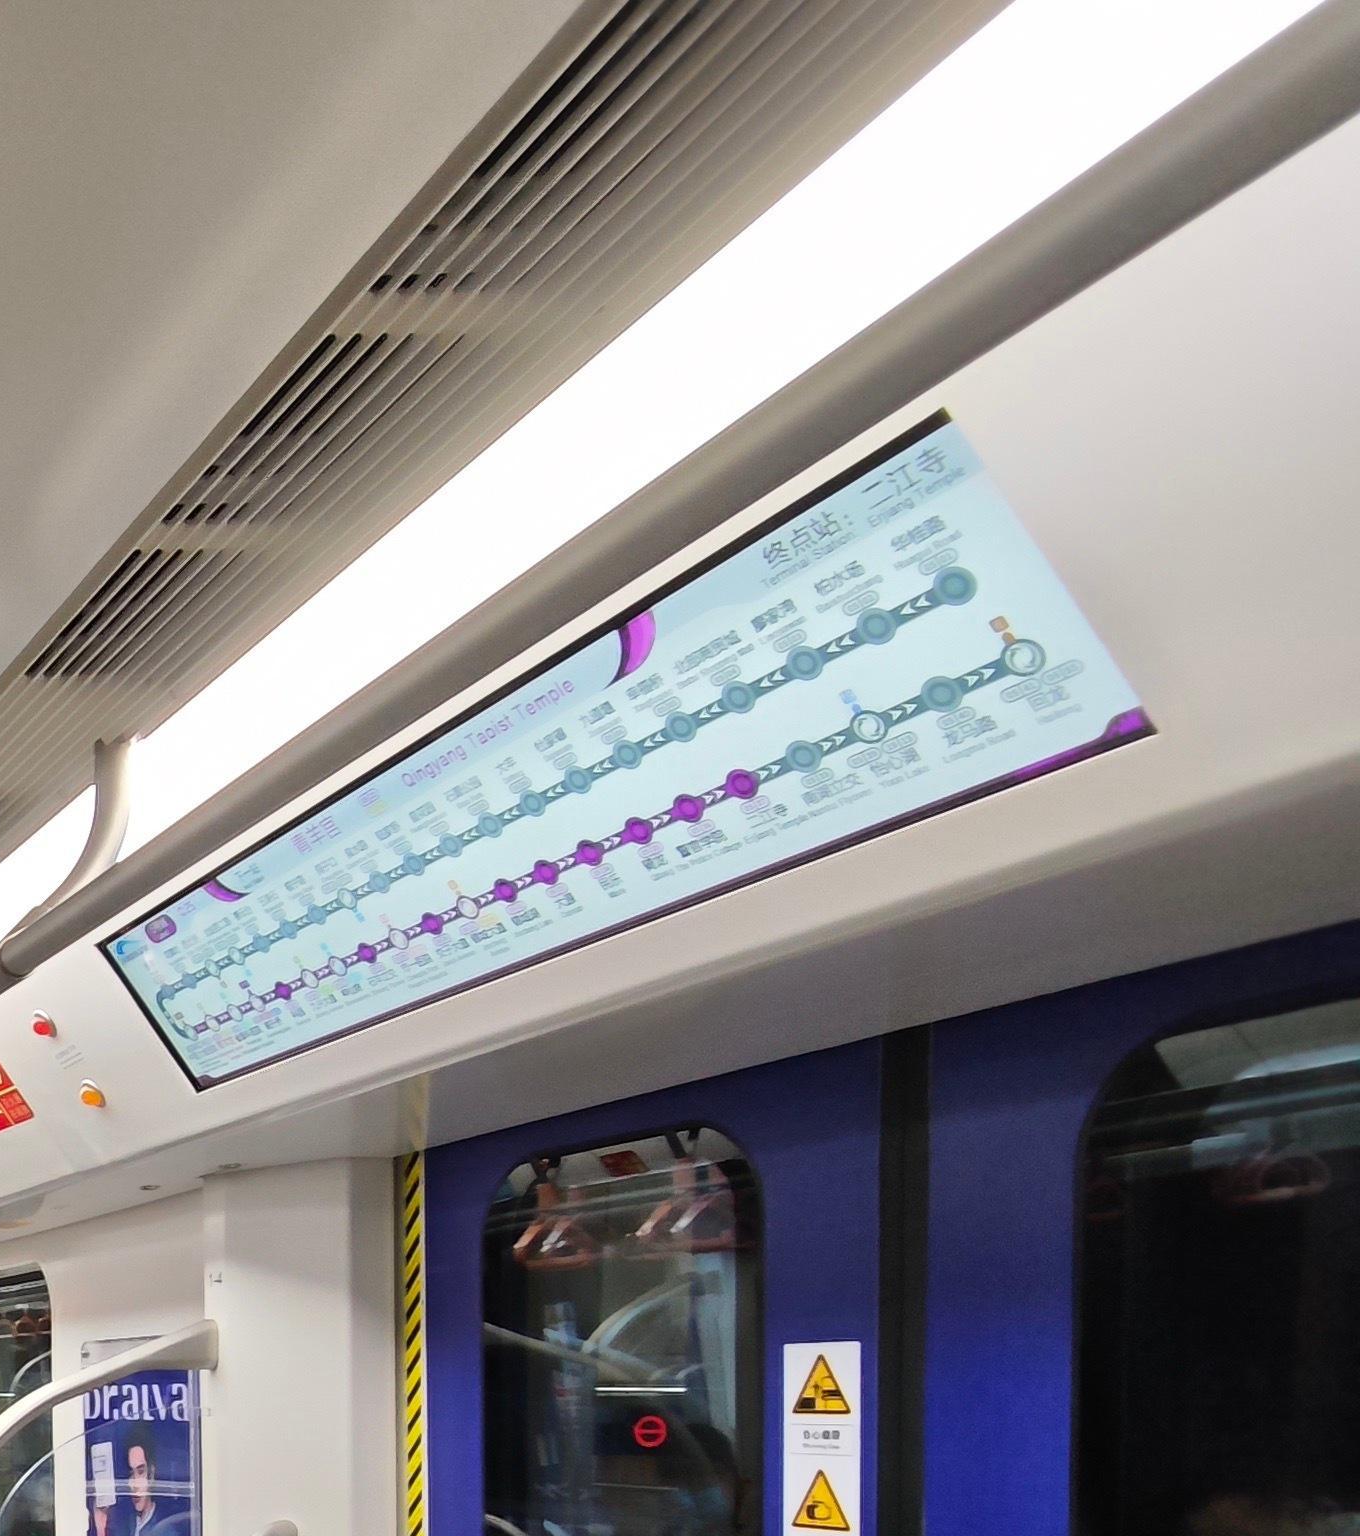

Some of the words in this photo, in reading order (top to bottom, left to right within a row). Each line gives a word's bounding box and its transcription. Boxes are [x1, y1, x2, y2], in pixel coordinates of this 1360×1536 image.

[860, 445, 949, 508] 二江寺
[401, 743, 467, 788] Qingyang
[466, 714, 513, 748] Taoist
[513, 678, 576, 722] Temple
